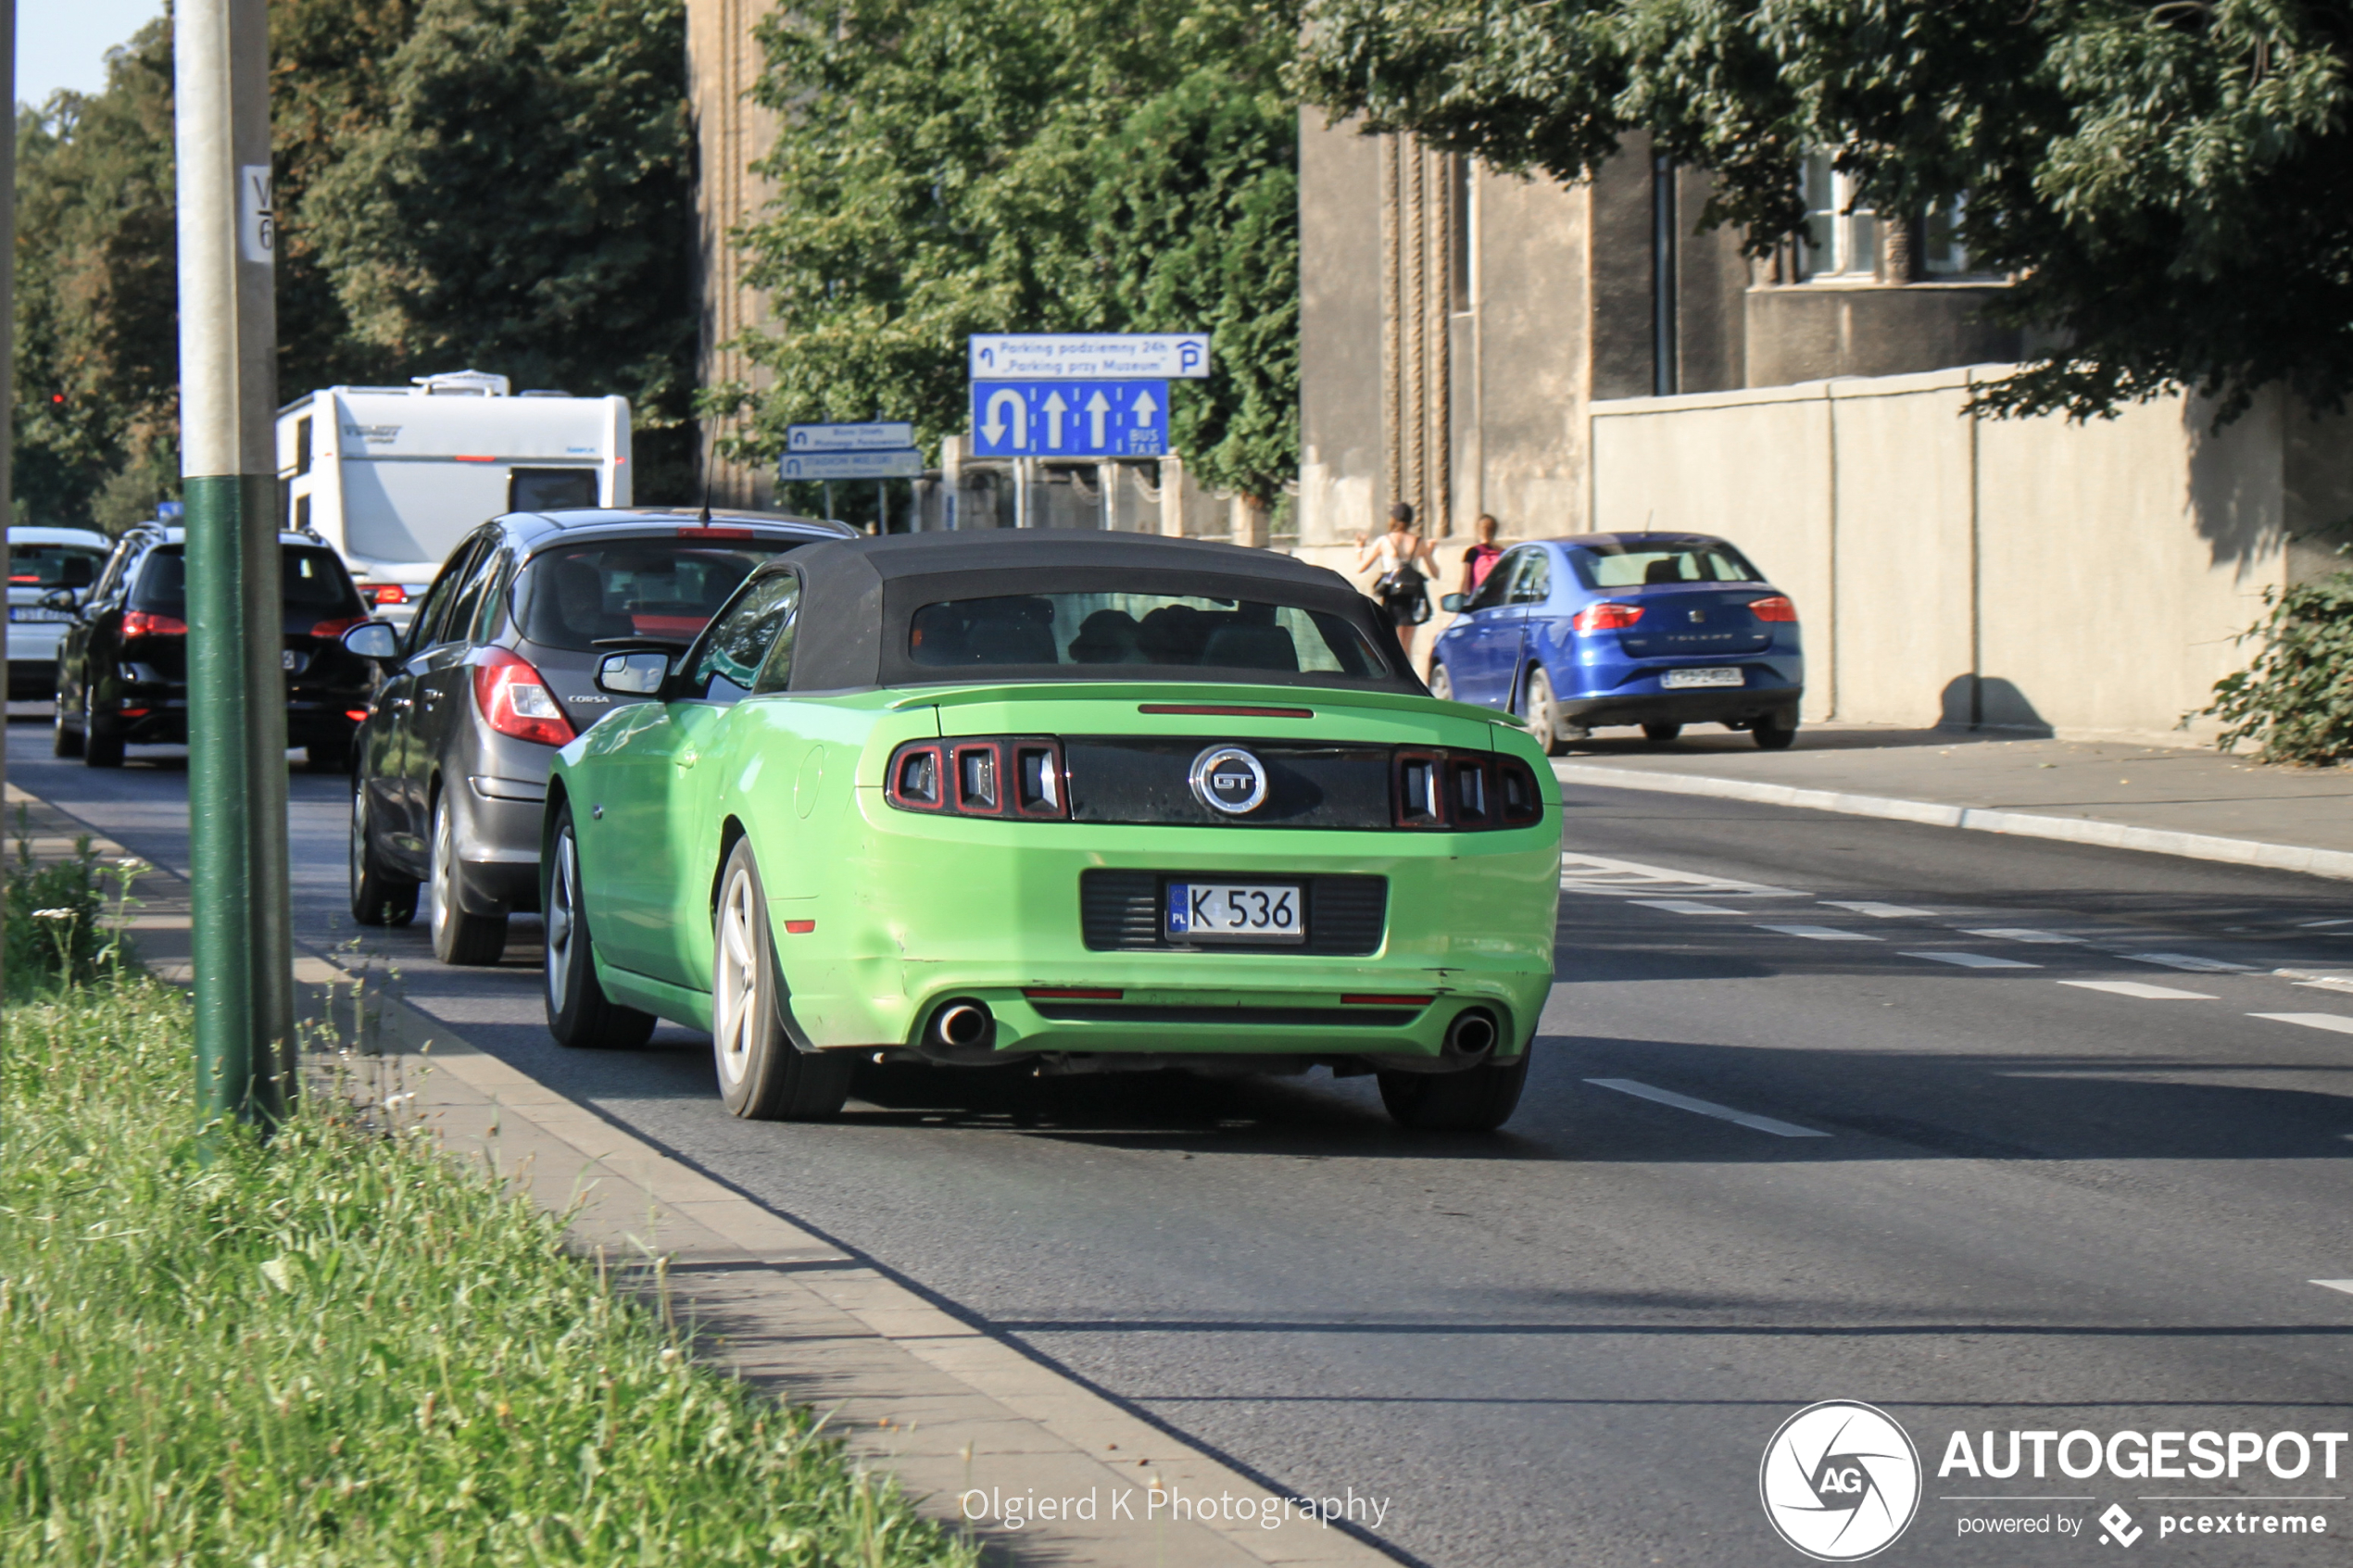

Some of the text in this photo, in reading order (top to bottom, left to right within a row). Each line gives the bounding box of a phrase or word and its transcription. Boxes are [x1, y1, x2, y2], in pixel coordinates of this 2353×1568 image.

[1000, 341, 1168, 357] Parking podziemny 24h
[1069, 362, 1097, 374] przy
[1129, 429, 1159, 443] BUS
[1128, 443, 1161, 455] TAXI
[568, 695, 610, 704] CORSA
[1214, 773, 1253, 789] GT
[1191, 889, 1292, 929] K 536
[1172, 912, 1186, 924] PL
